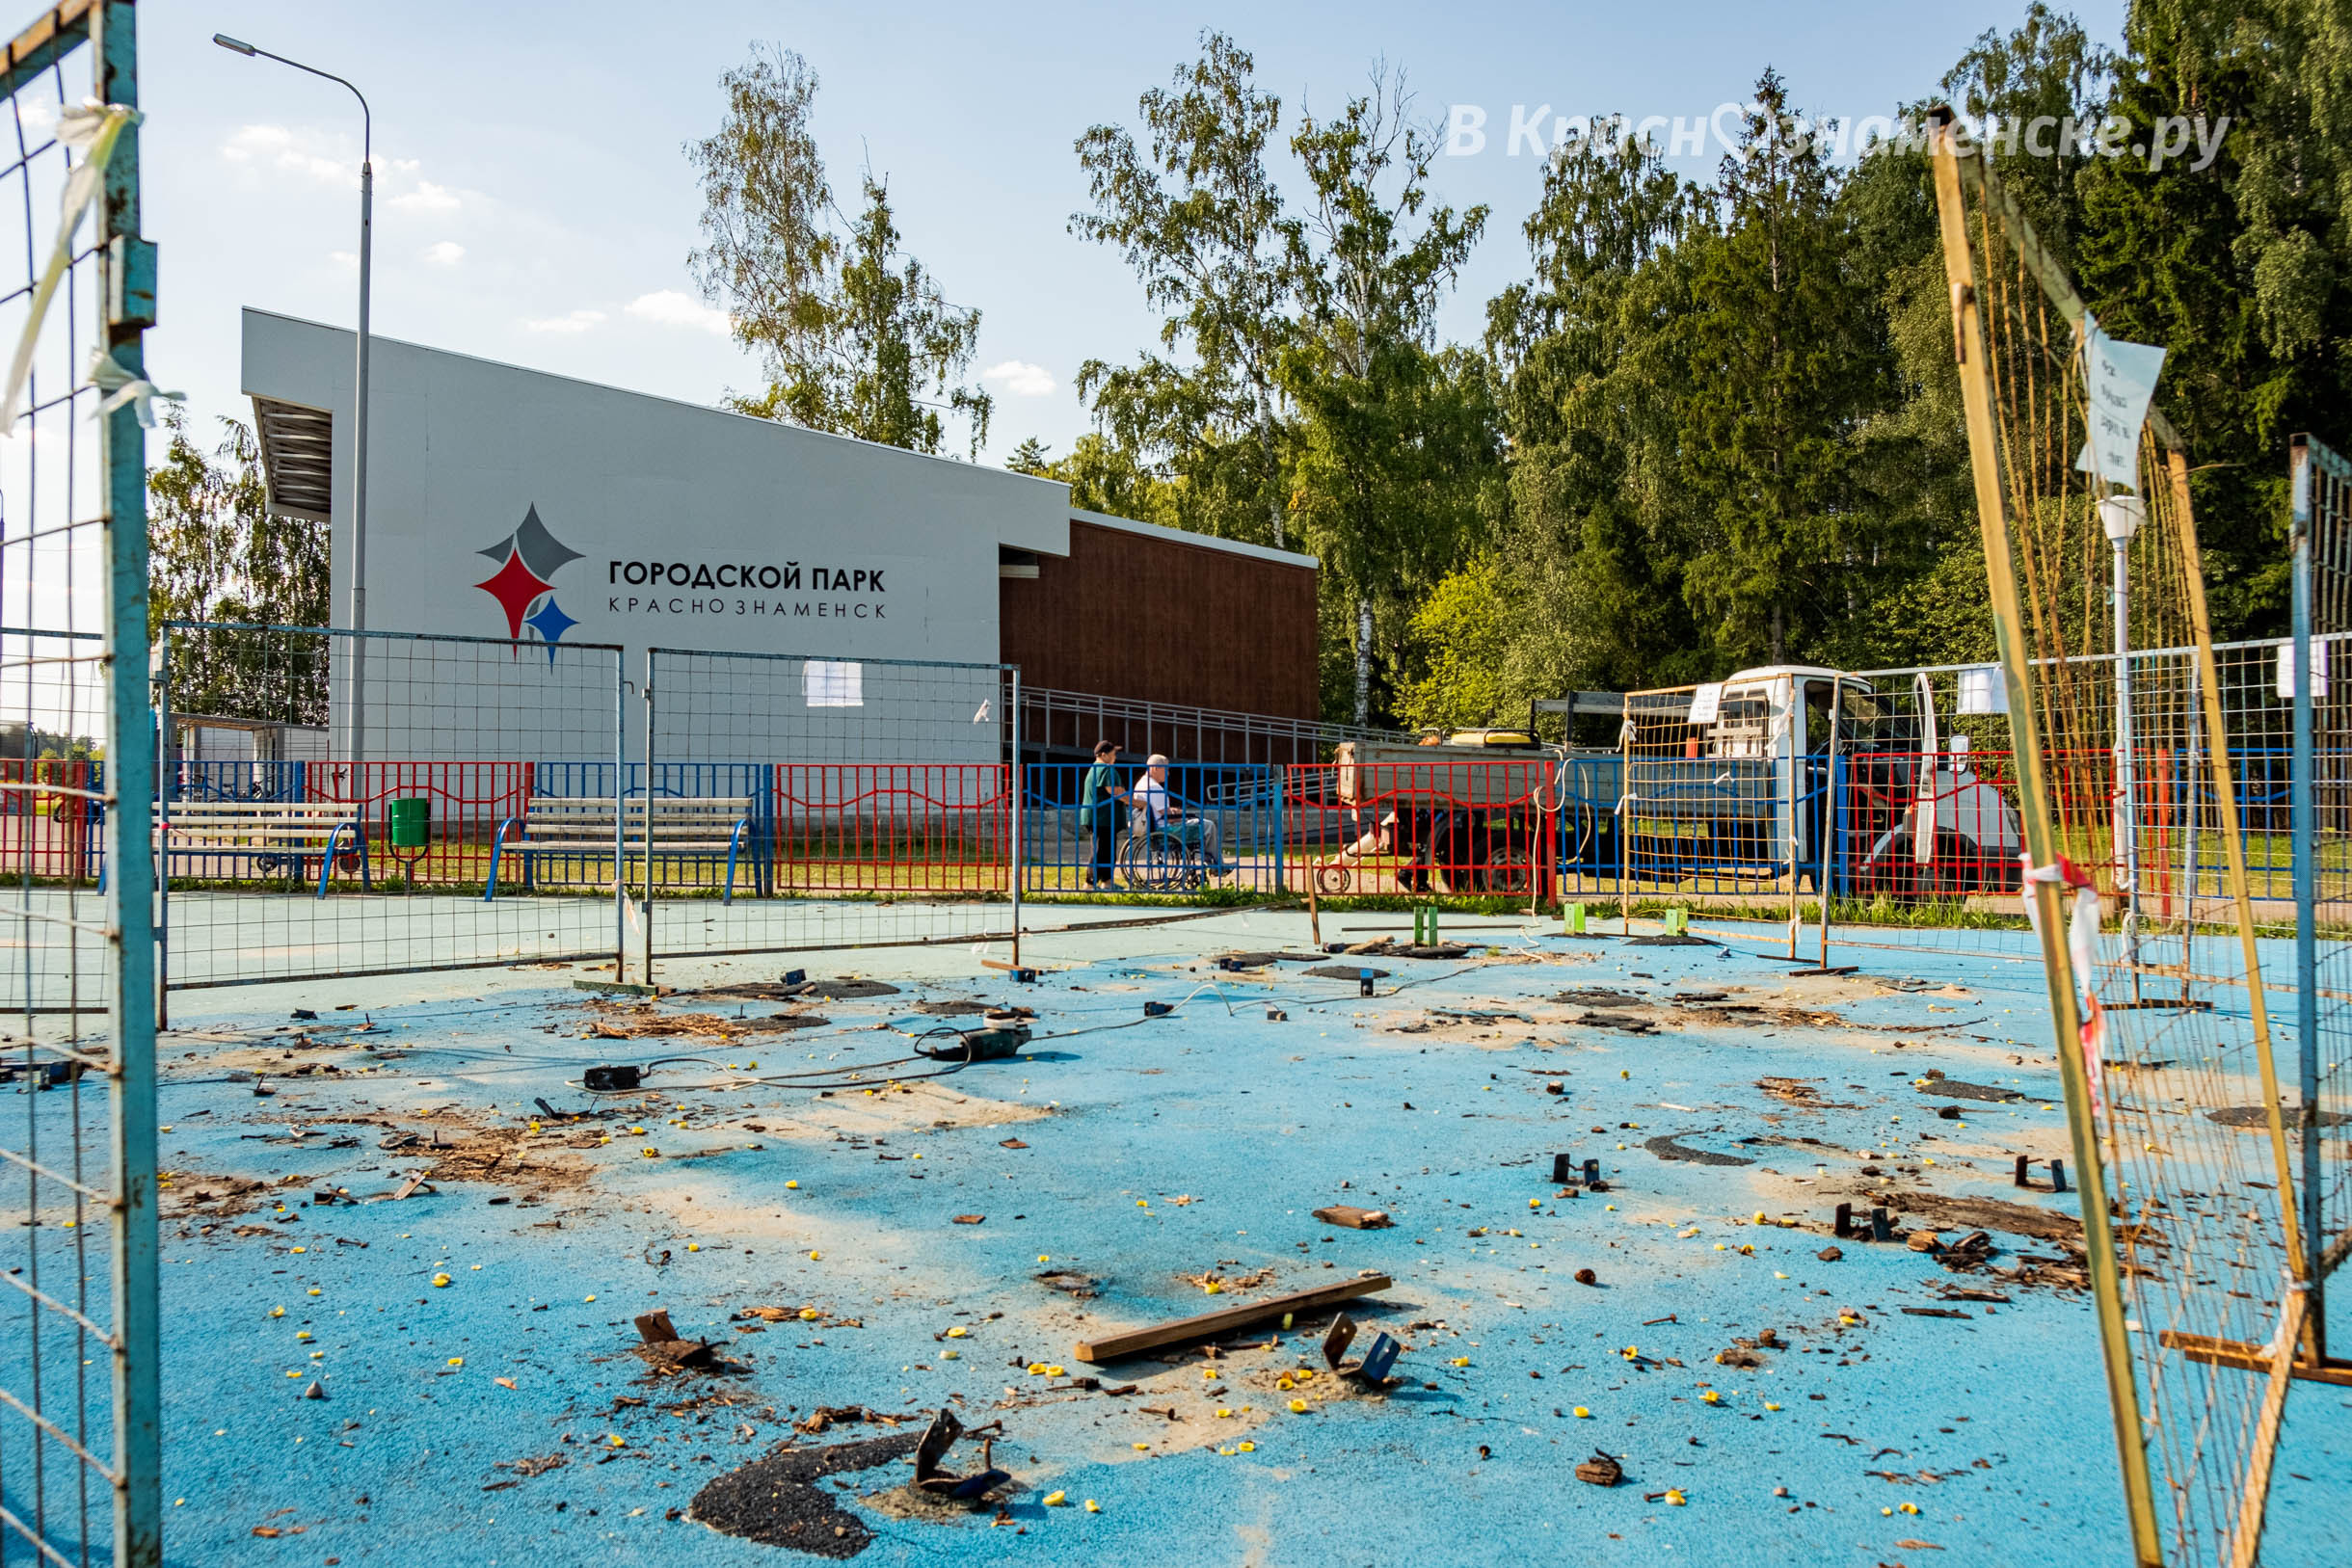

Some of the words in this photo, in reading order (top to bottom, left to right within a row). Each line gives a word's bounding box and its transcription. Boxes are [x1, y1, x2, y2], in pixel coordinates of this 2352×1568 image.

[609, 561, 801, 590] ГОРОДСКОЙ
[812, 568, 886, 593] ПАРК
[609, 597, 887, 619] КРАСНОЗНАМЕНСК
